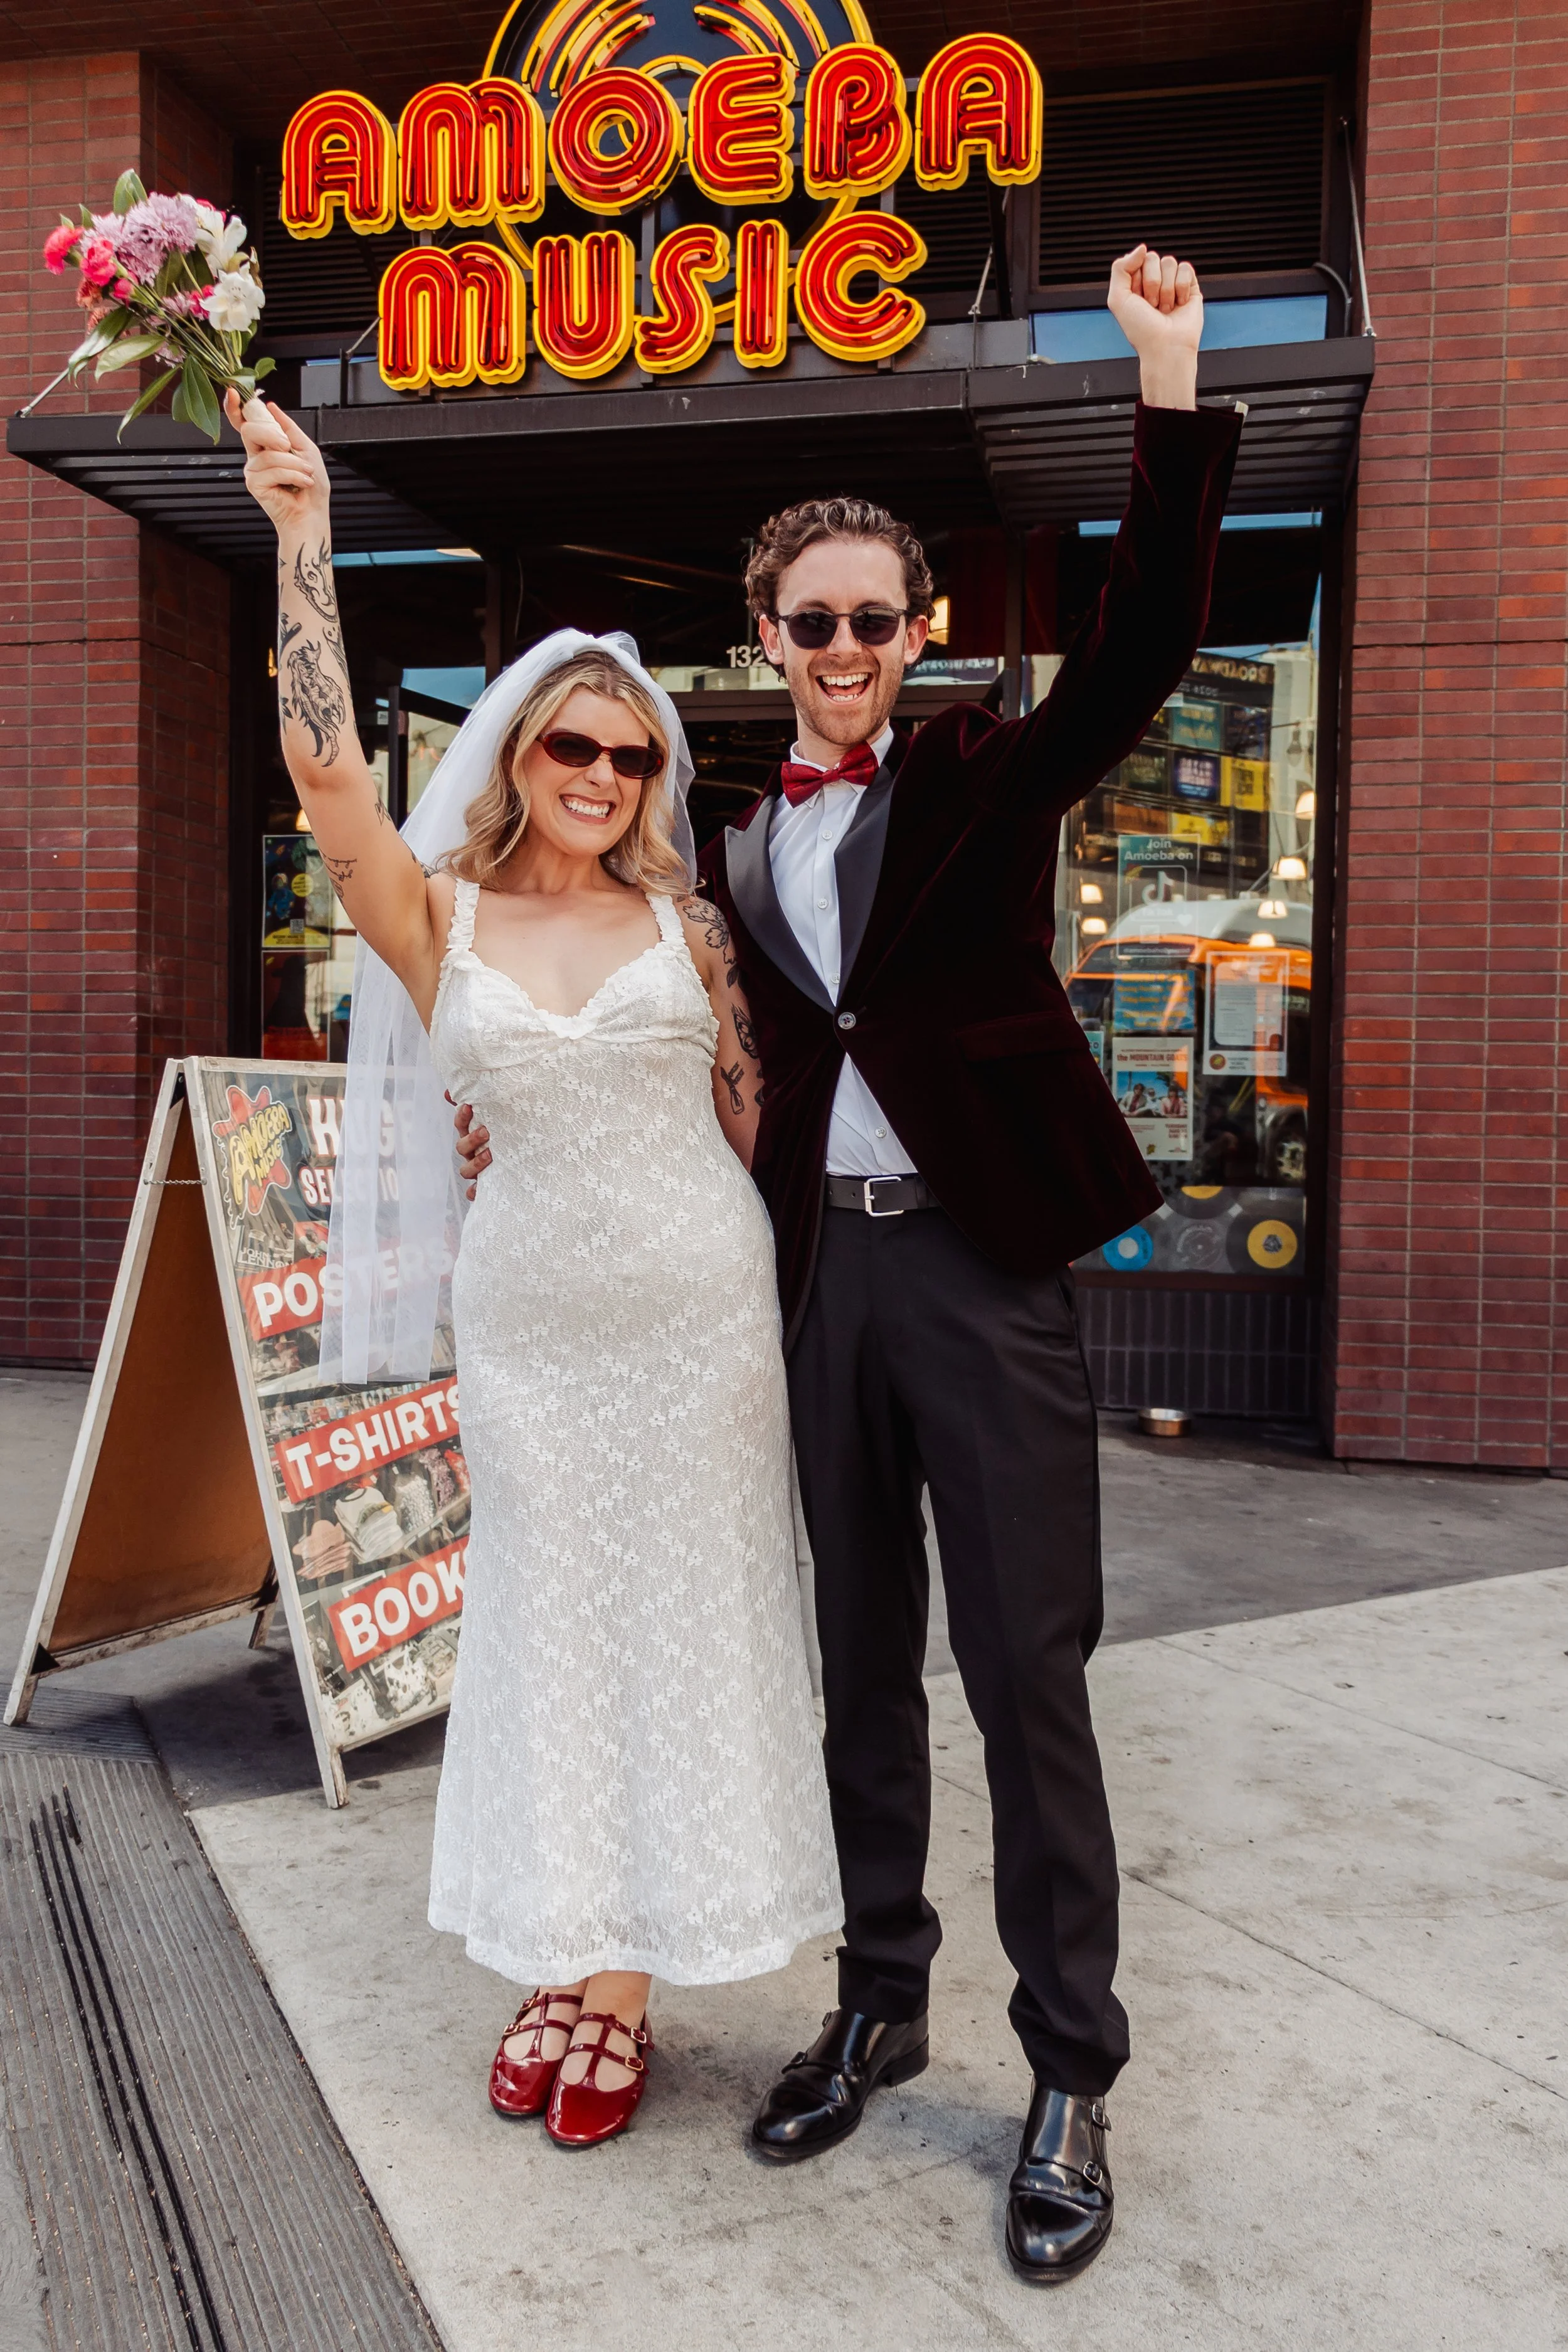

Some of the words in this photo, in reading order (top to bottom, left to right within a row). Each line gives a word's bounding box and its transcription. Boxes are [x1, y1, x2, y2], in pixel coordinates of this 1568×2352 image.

[282, 32, 1043, 239] AMOEBA
[378, 210, 928, 390] MUSIC
[1124, 850, 1175, 861] Amoeba
[1178, 851, 1193, 860] on
[229, 1104, 291, 1205] AMOEBA
[255, 1138, 282, 1188] MUSIC
[240, 1247, 270, 1259] JOHN
[253, 1237, 453, 1327] POSTERS
[339, 1549, 469, 1658] BOOK
